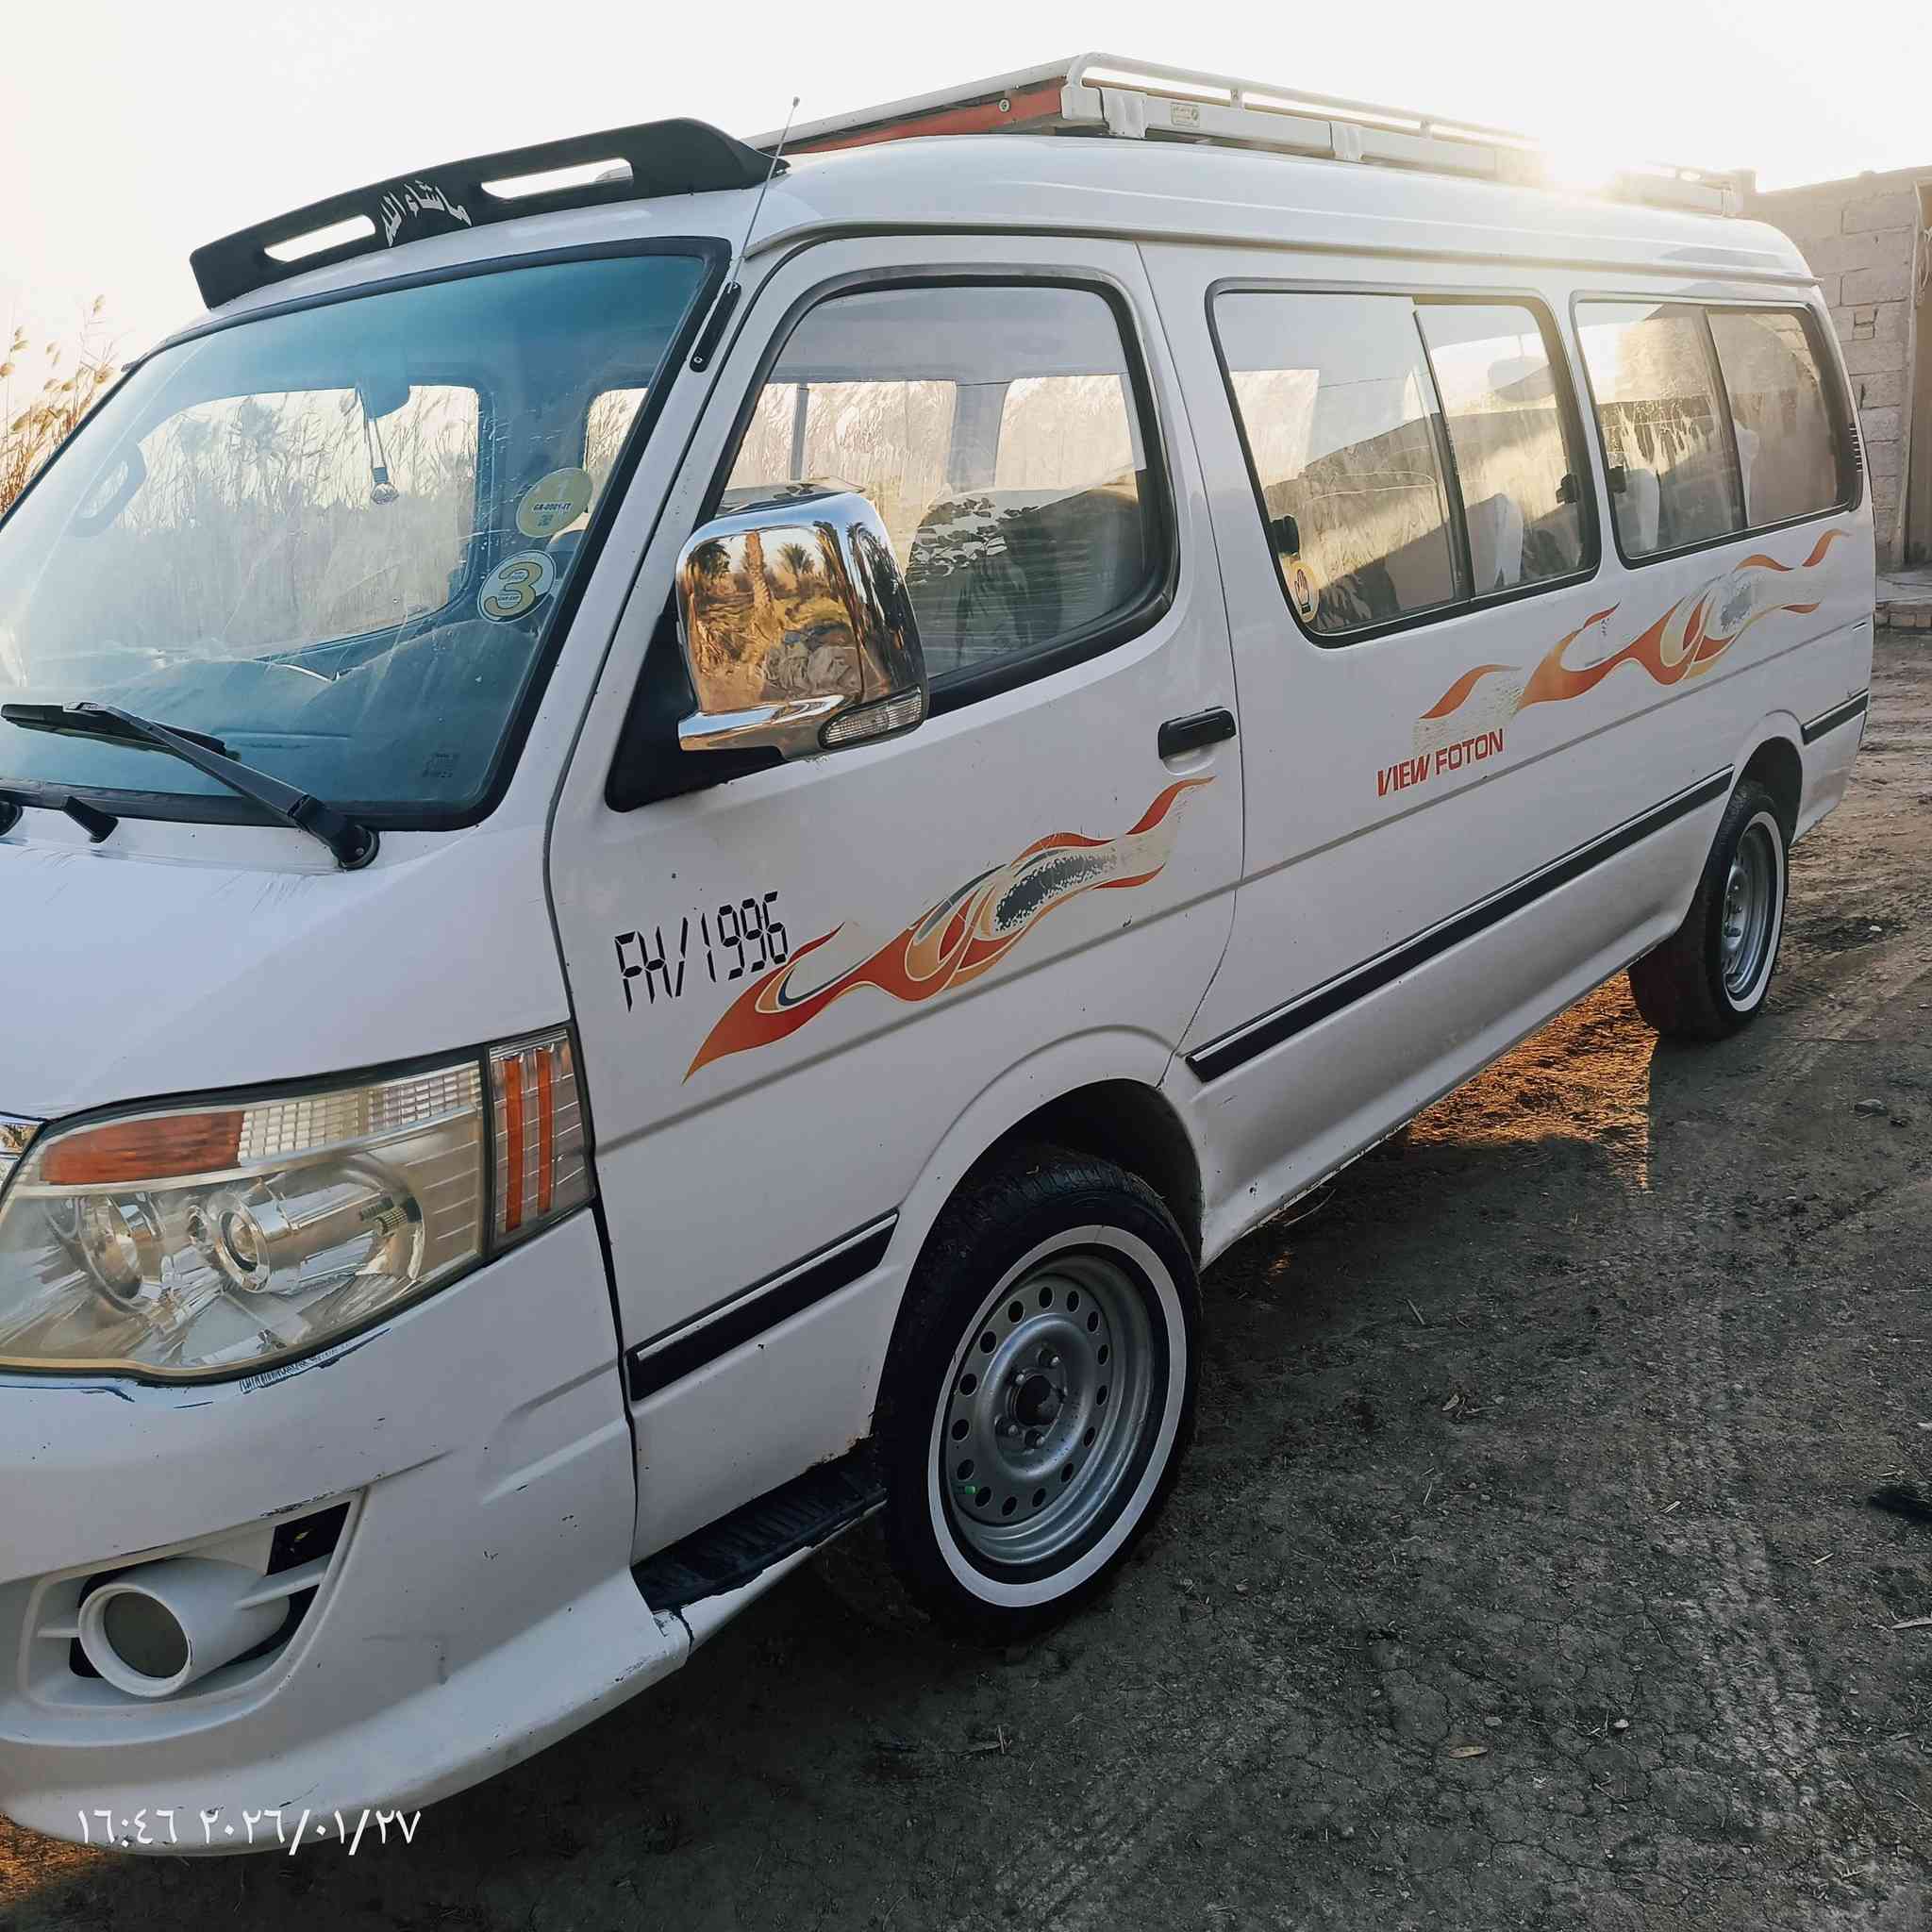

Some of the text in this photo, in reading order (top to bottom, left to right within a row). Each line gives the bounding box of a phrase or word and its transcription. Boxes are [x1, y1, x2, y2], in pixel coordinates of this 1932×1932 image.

[483, 560, 543, 618] 3
[1376, 727, 1504, 797] VIEW FOTON
